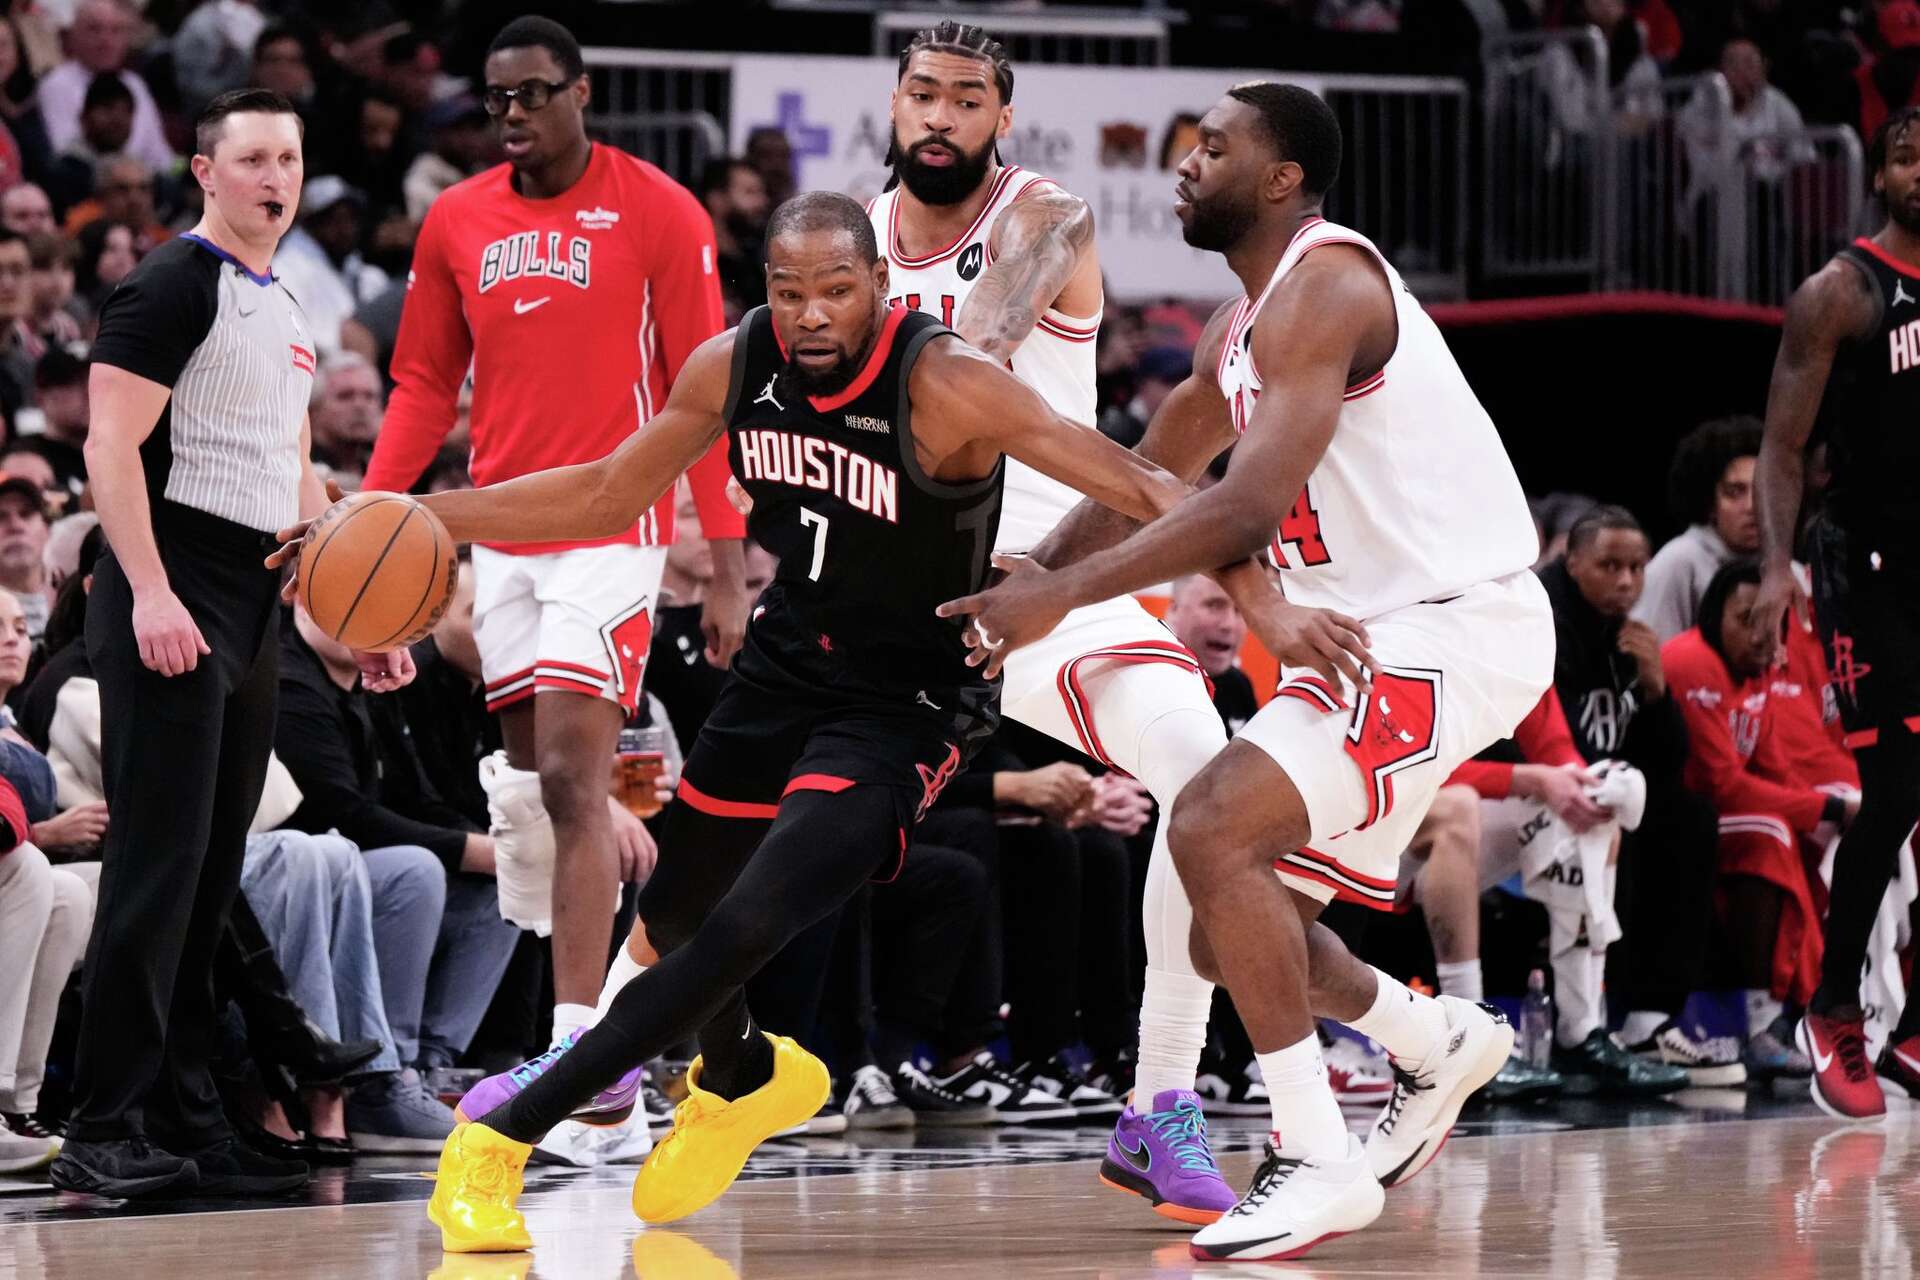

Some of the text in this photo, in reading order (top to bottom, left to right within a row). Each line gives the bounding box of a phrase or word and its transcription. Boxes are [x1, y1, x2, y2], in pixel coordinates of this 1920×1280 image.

[479, 230, 591, 293] BULLS
[844, 414, 888, 428] MEMORIAL
[845, 420, 890, 434] HERMANN
[737, 429, 898, 525] HOUSTON
[800, 506, 829, 582] 7
